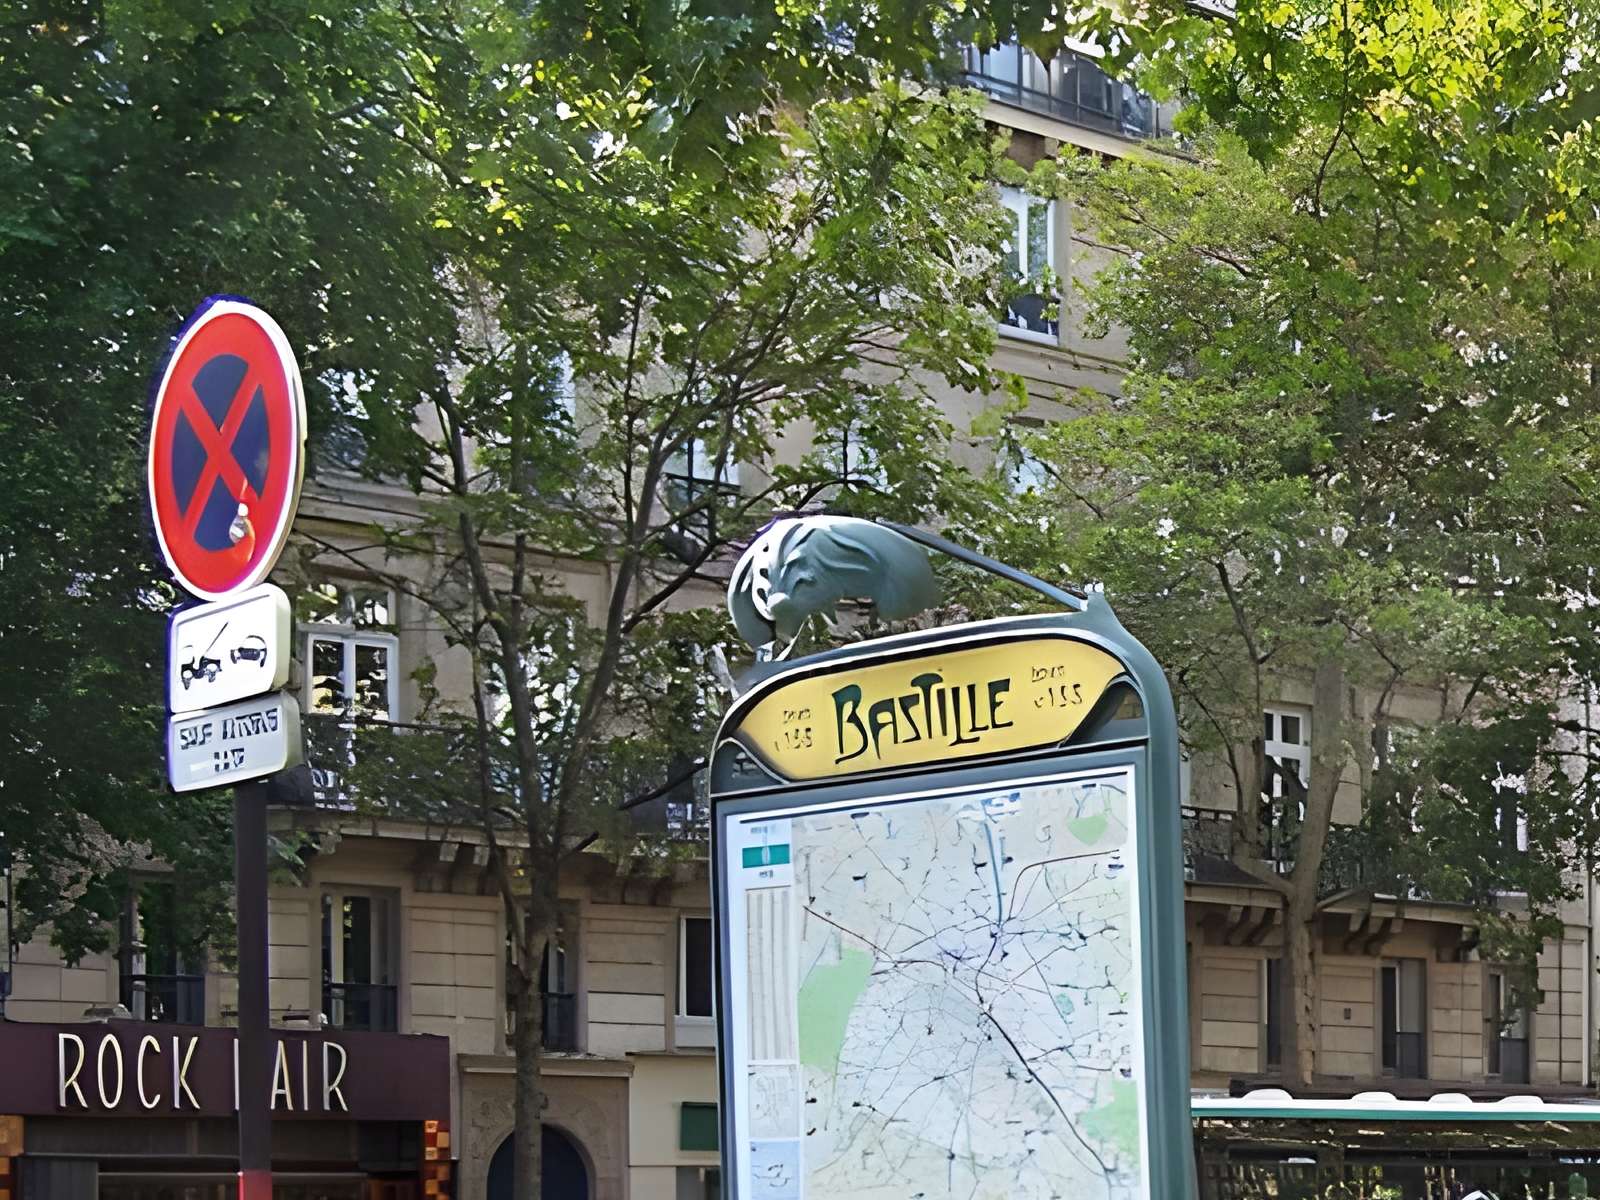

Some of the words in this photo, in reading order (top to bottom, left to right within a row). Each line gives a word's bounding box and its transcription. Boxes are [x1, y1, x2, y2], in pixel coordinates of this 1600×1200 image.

[832, 670, 1014, 765] BASTILLE
[58, 1032, 200, 1110] ROCK
[233, 1037, 349, 1112] AIR
